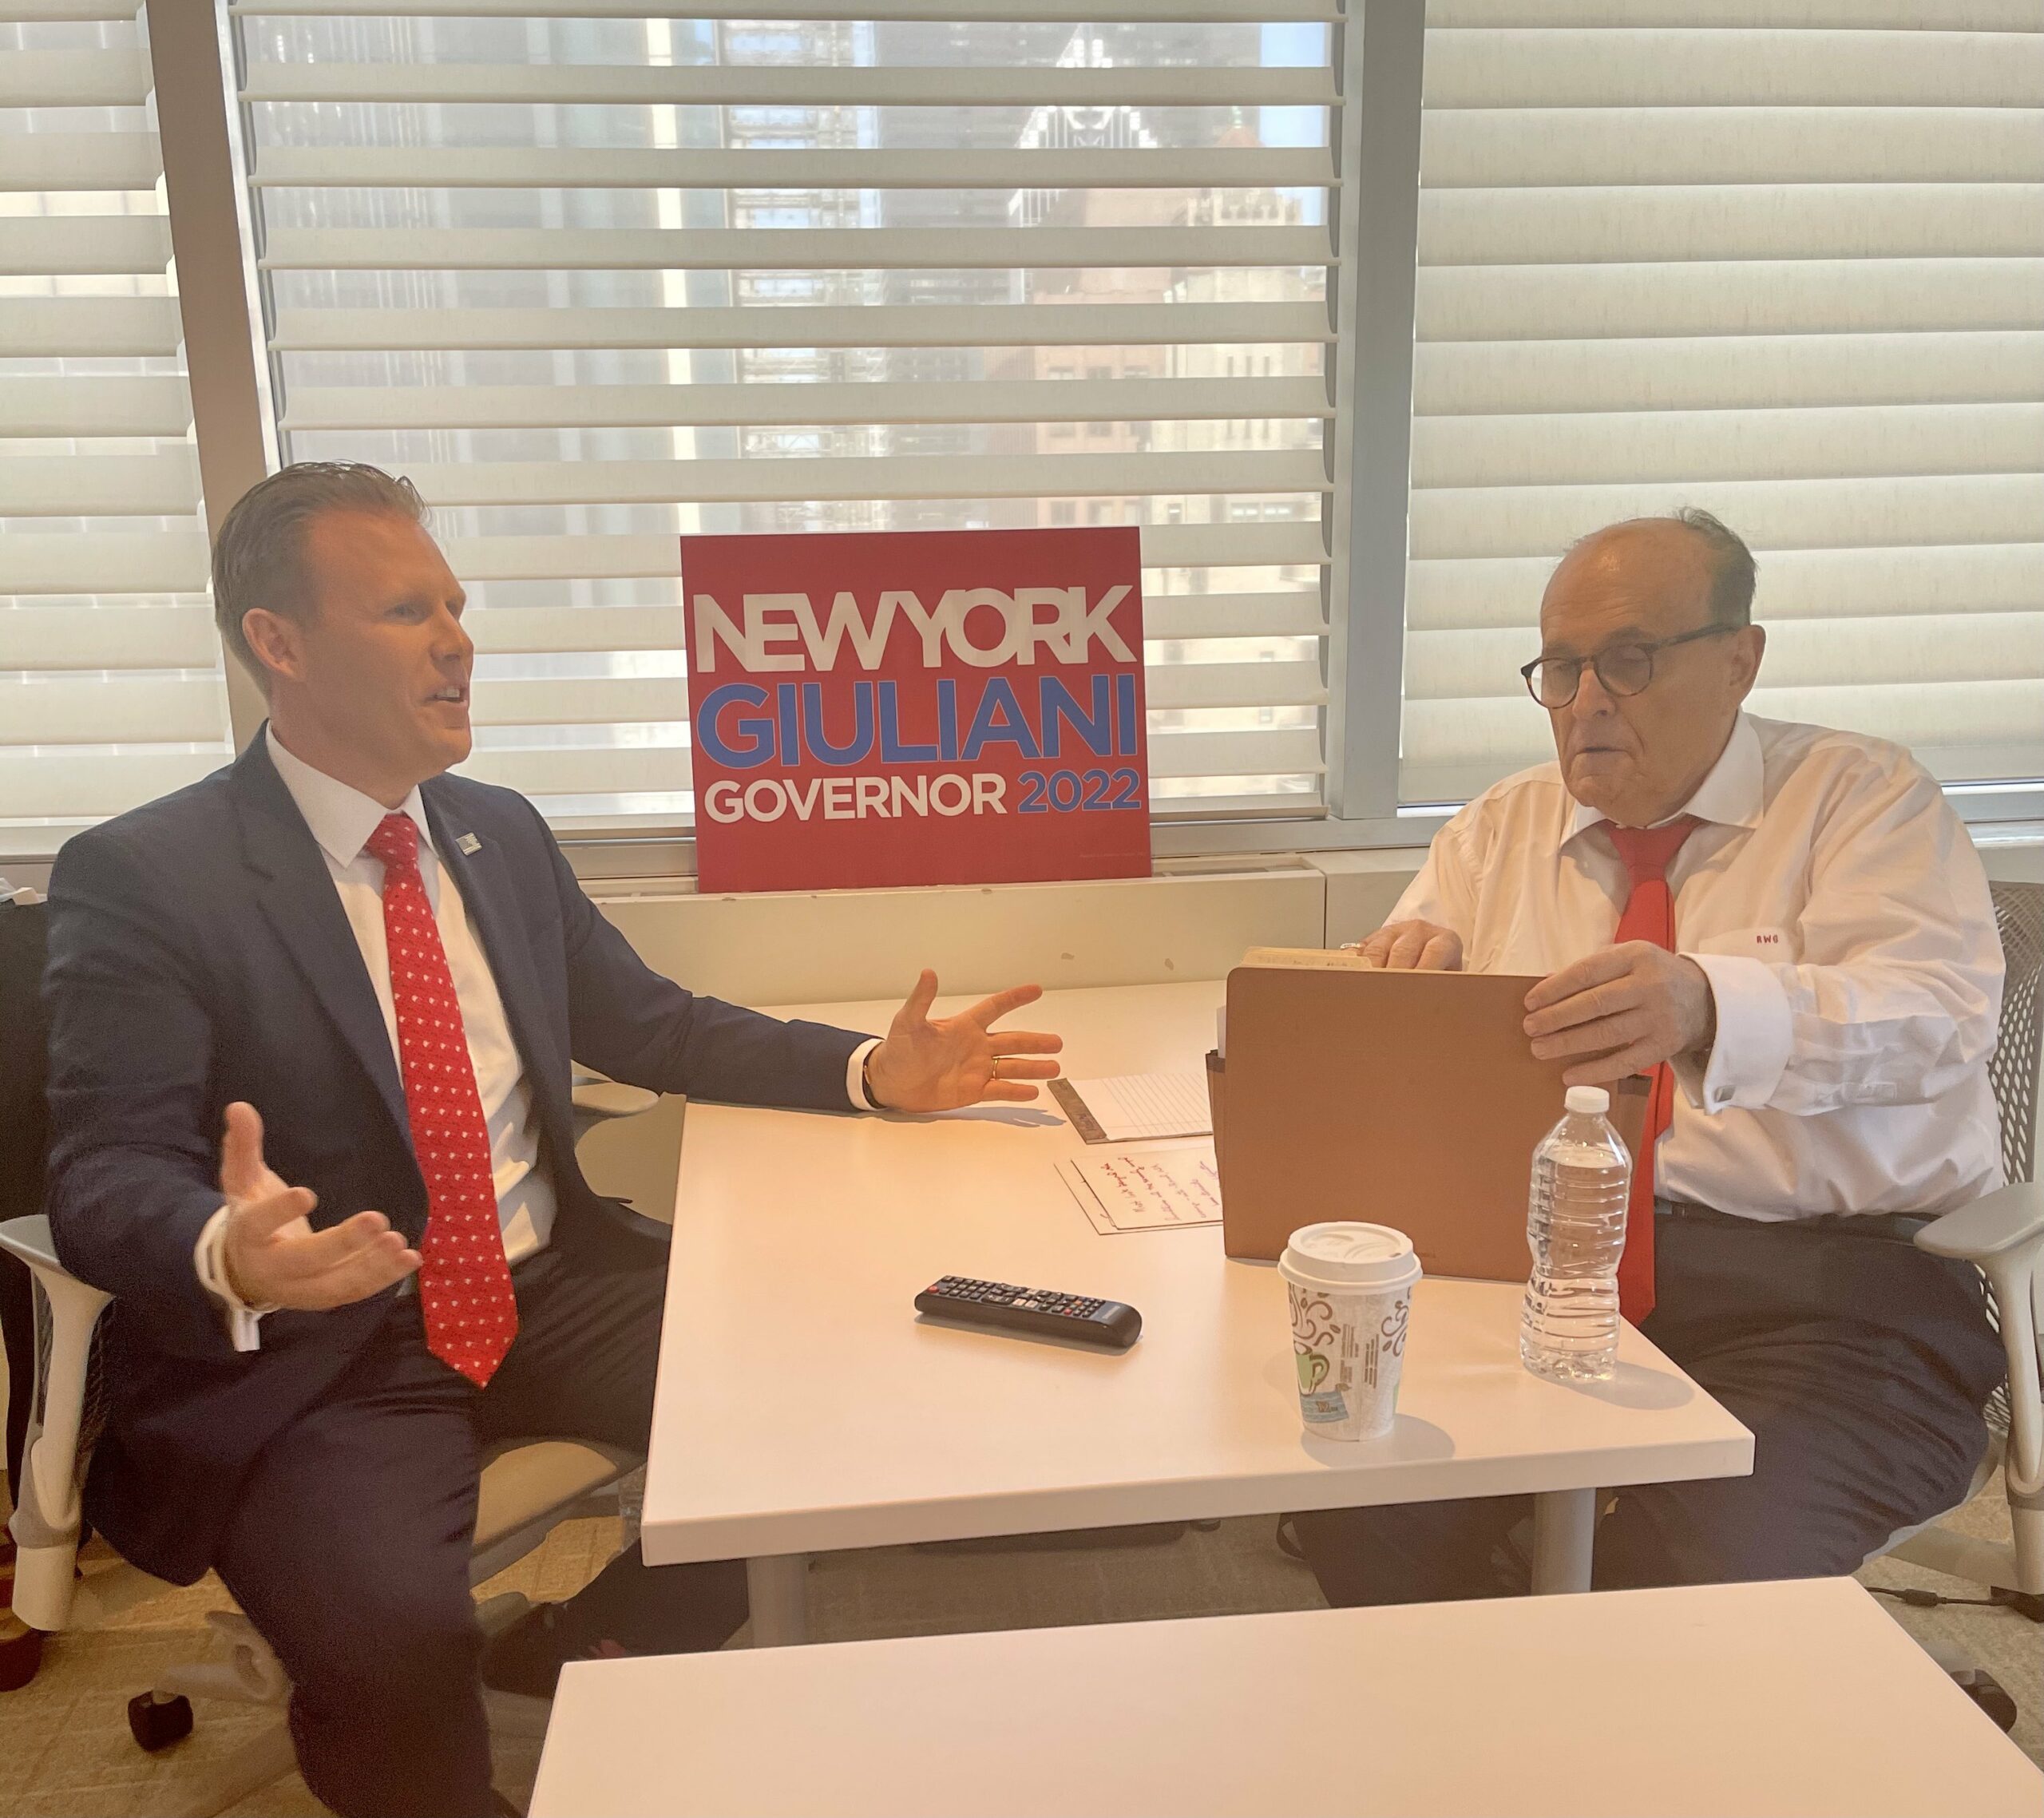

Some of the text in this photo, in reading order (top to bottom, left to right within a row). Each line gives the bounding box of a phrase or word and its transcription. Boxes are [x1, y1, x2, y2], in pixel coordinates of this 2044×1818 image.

[697, 674, 1137, 769] GIULIANI
[704, 767, 1141, 823] GOVERNOR 2022
[1757, 934, 1778, 944] RWG
